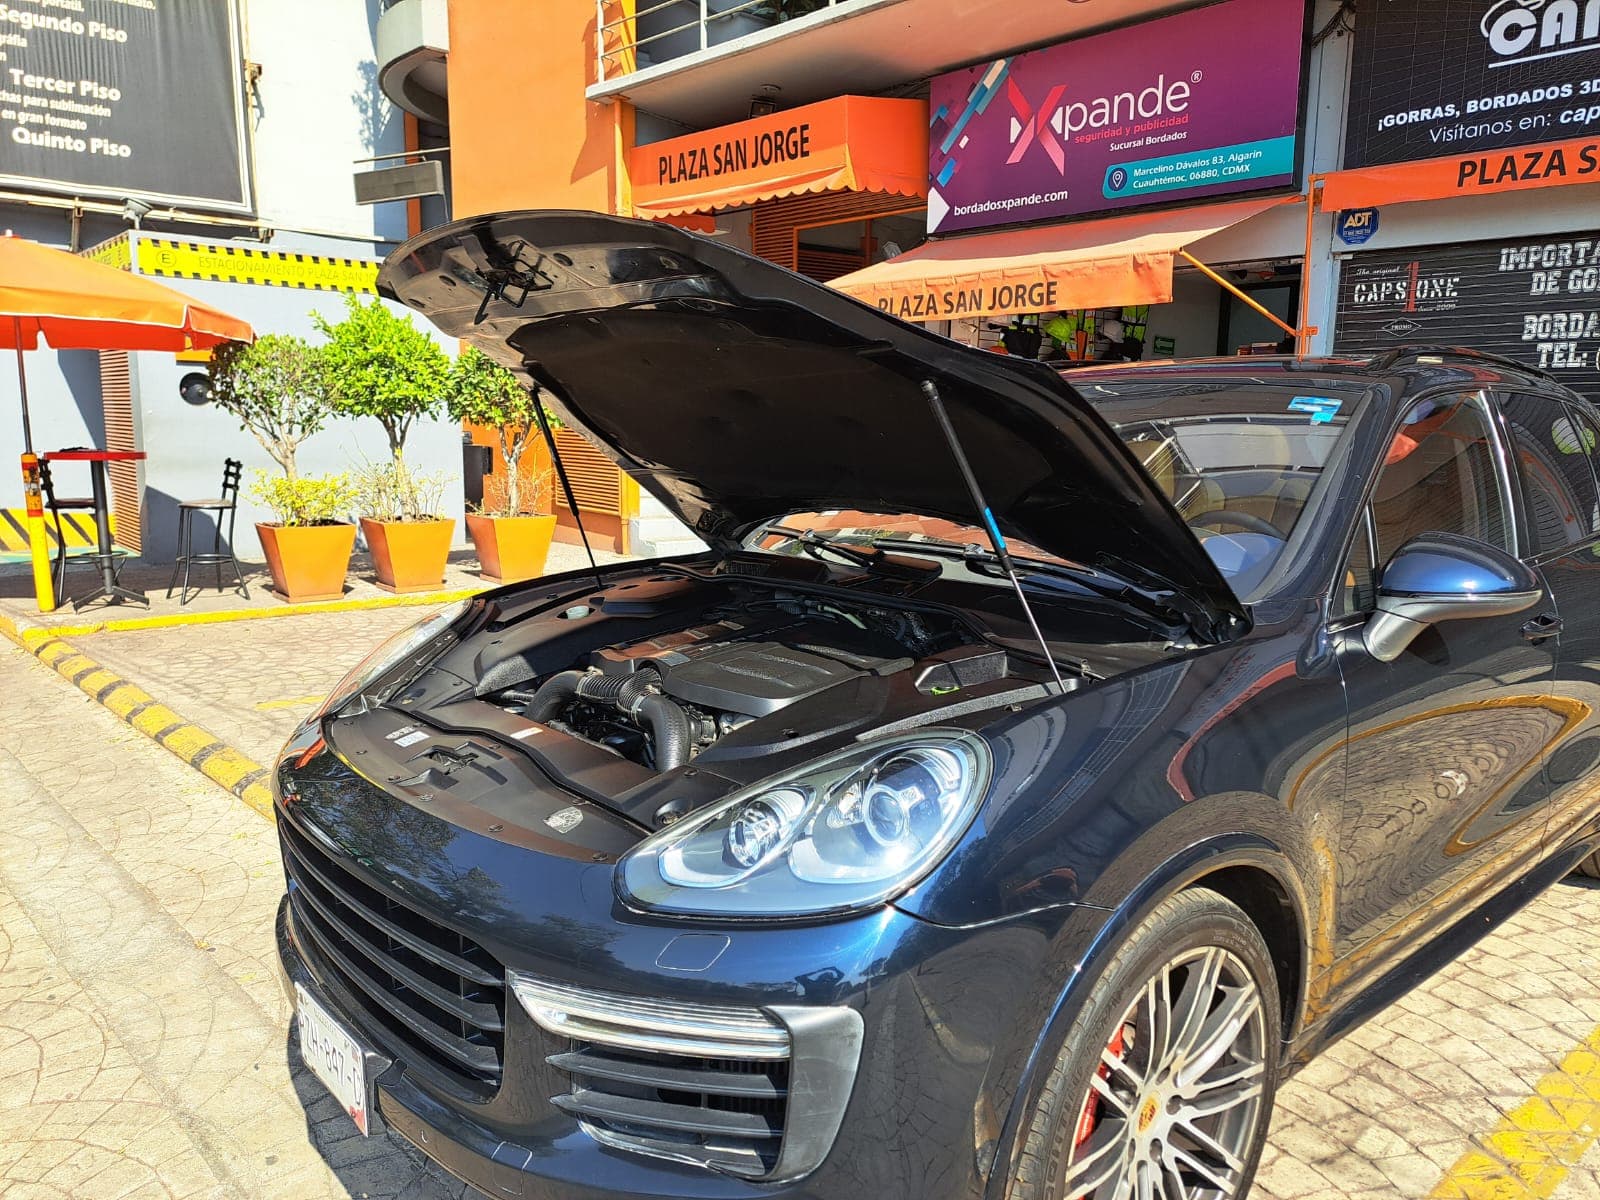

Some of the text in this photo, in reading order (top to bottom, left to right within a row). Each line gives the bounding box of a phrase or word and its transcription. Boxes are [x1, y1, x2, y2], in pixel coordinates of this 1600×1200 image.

[0, 4, 128, 42] Segundo Piso
[9, 68, 121, 101] Tercer Piso
[23, 95, 48, 107] para
[1378, 104, 1460, 131] ¡GORRAS,
[1466, 83, 1573, 113] BORDADOS
[17, 111, 43, 124] gran
[45, 113, 87, 130] formato
[1074, 114, 1189, 144] seguridad y publicidad
[1429, 120, 1513, 143] Visítanos
[1518, 114, 1552, 129] en:
[12, 126, 131, 157] Quinto Piso
[659, 124, 809, 185] PLAZA SAN JORGE
[1109, 131, 1187, 152] Sucursal Bordados
[1133, 164, 1174, 177] Marcelino
[1175, 158, 1210, 171] Dávalos
[1222, 164, 1250, 176] CDMX
[1457, 149, 1567, 188] PLAZA
[954, 191, 1068, 216] bordadosxpande.com
[1344, 212, 1372, 228] ADT
[199, 256, 305, 277] ESTACIONAMIENTO
[308, 268, 339, 280] PLAZA
[1530, 267, 1600, 296] DE GO
[878, 281, 1057, 317] PLAZA SAN JORGE
[1537, 342, 1588, 368] TEL:
